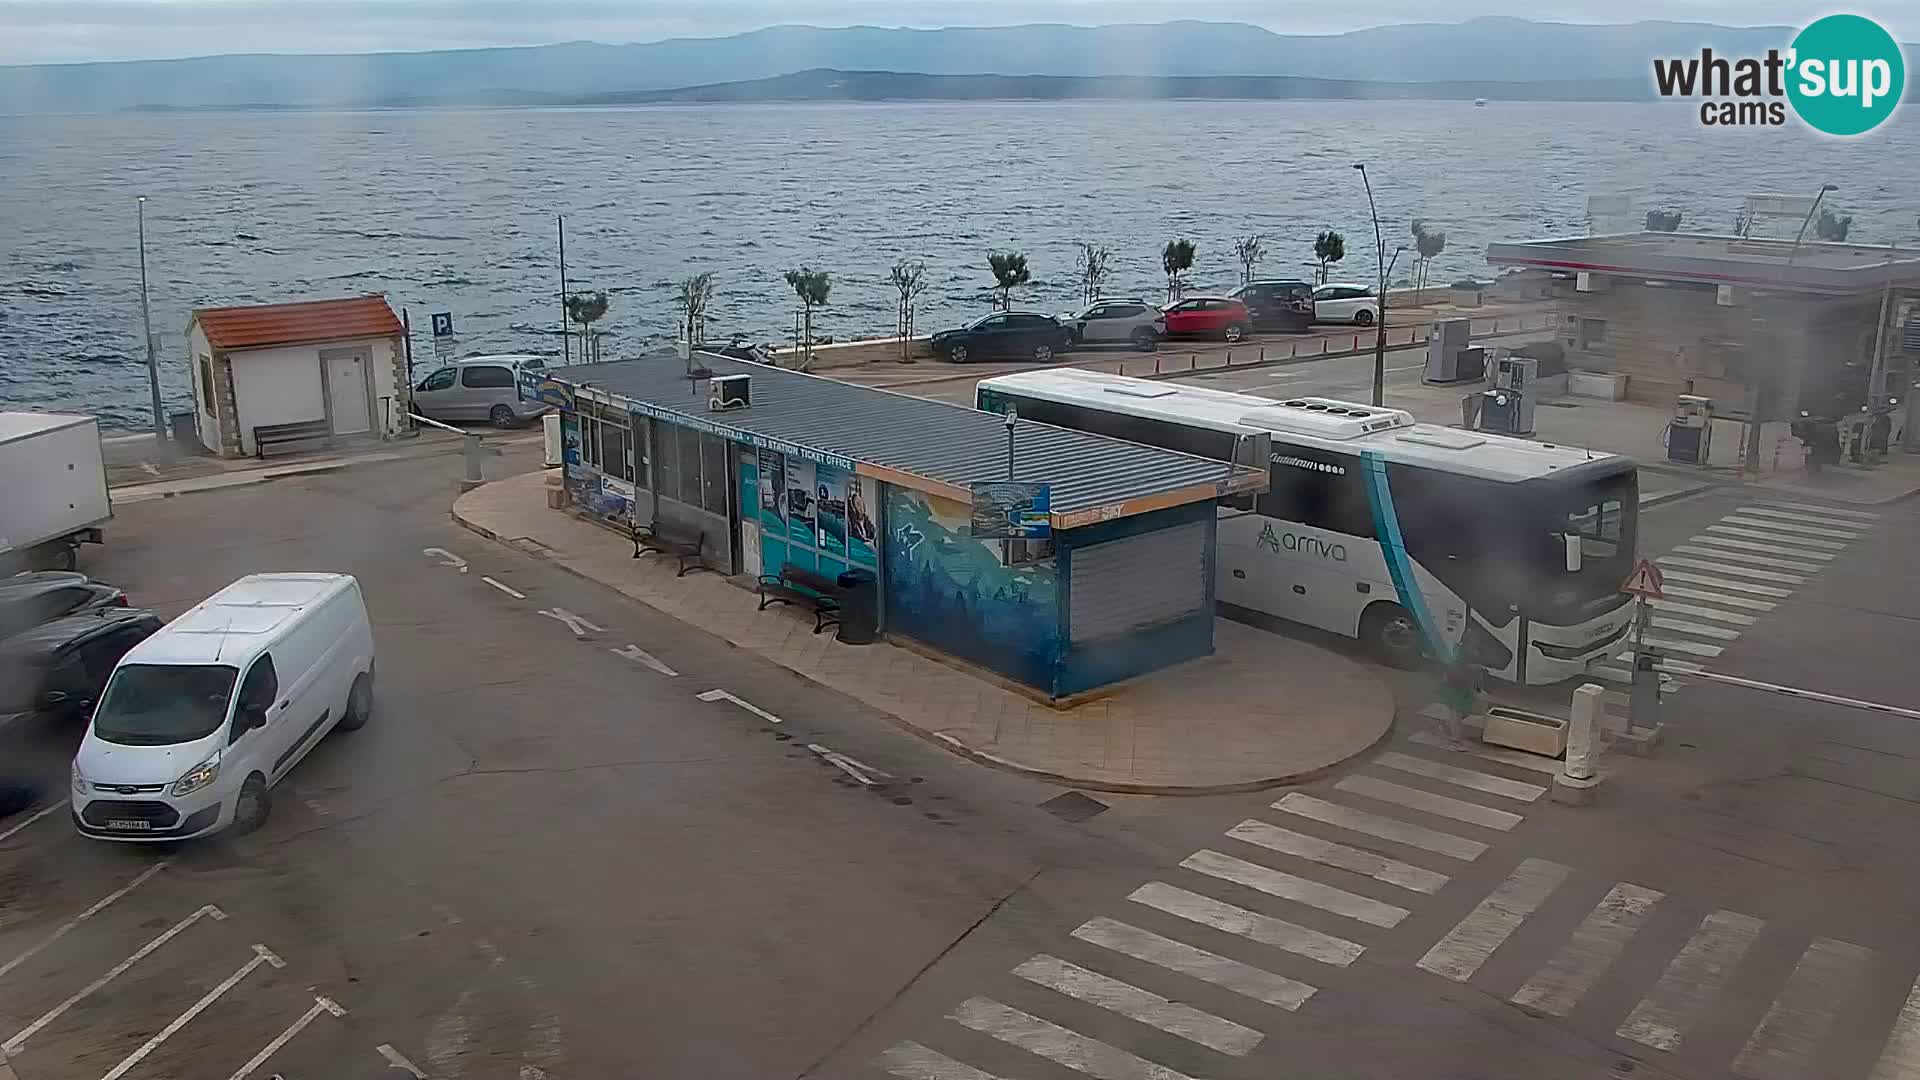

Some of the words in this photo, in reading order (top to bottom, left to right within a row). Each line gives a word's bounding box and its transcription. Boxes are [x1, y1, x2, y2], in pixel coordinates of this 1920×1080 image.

[436, 316, 448, 334] P
[753, 435, 768, 448] BUS
[767, 440, 799, 456] STATION
[801, 448, 825, 464] TICKET
[827, 455, 852, 470] OFFICE
[1282, 533, 1347, 562] arriva
